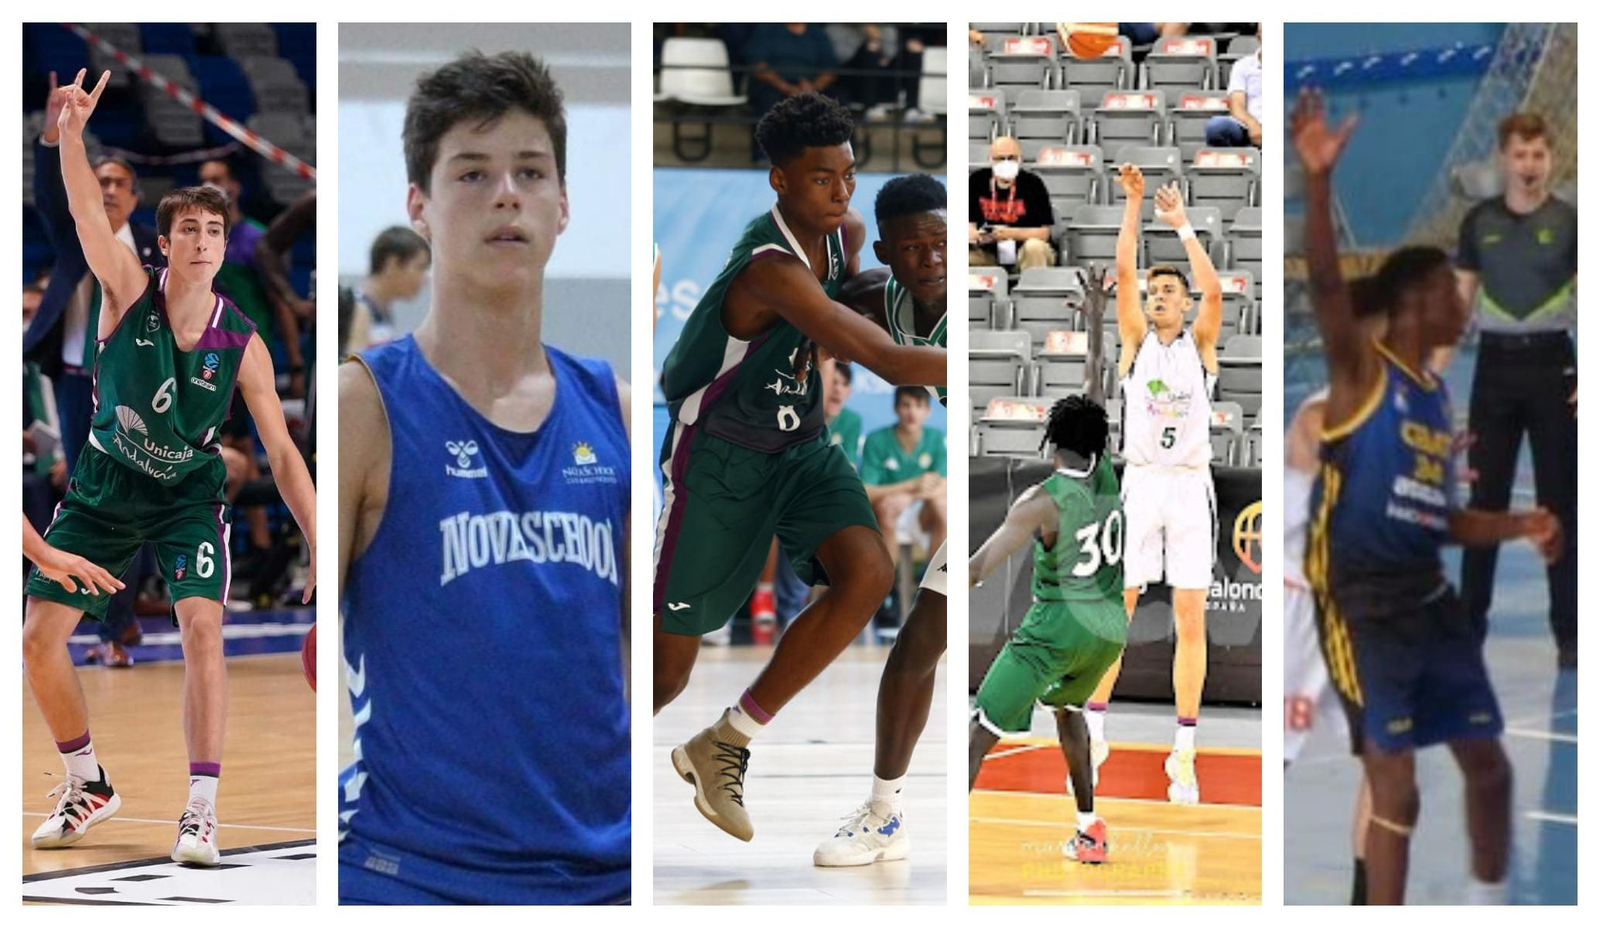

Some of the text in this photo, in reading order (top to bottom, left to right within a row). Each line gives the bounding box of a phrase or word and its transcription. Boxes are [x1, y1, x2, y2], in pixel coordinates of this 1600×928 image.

[152, 377, 176, 413] 6
[144, 438, 194, 461] Unicaja
[1160, 426, 1177, 449] 5
[445, 464, 488, 478] hummel
[1072, 509, 1123, 577] 30
[196, 541, 215, 579] 6
